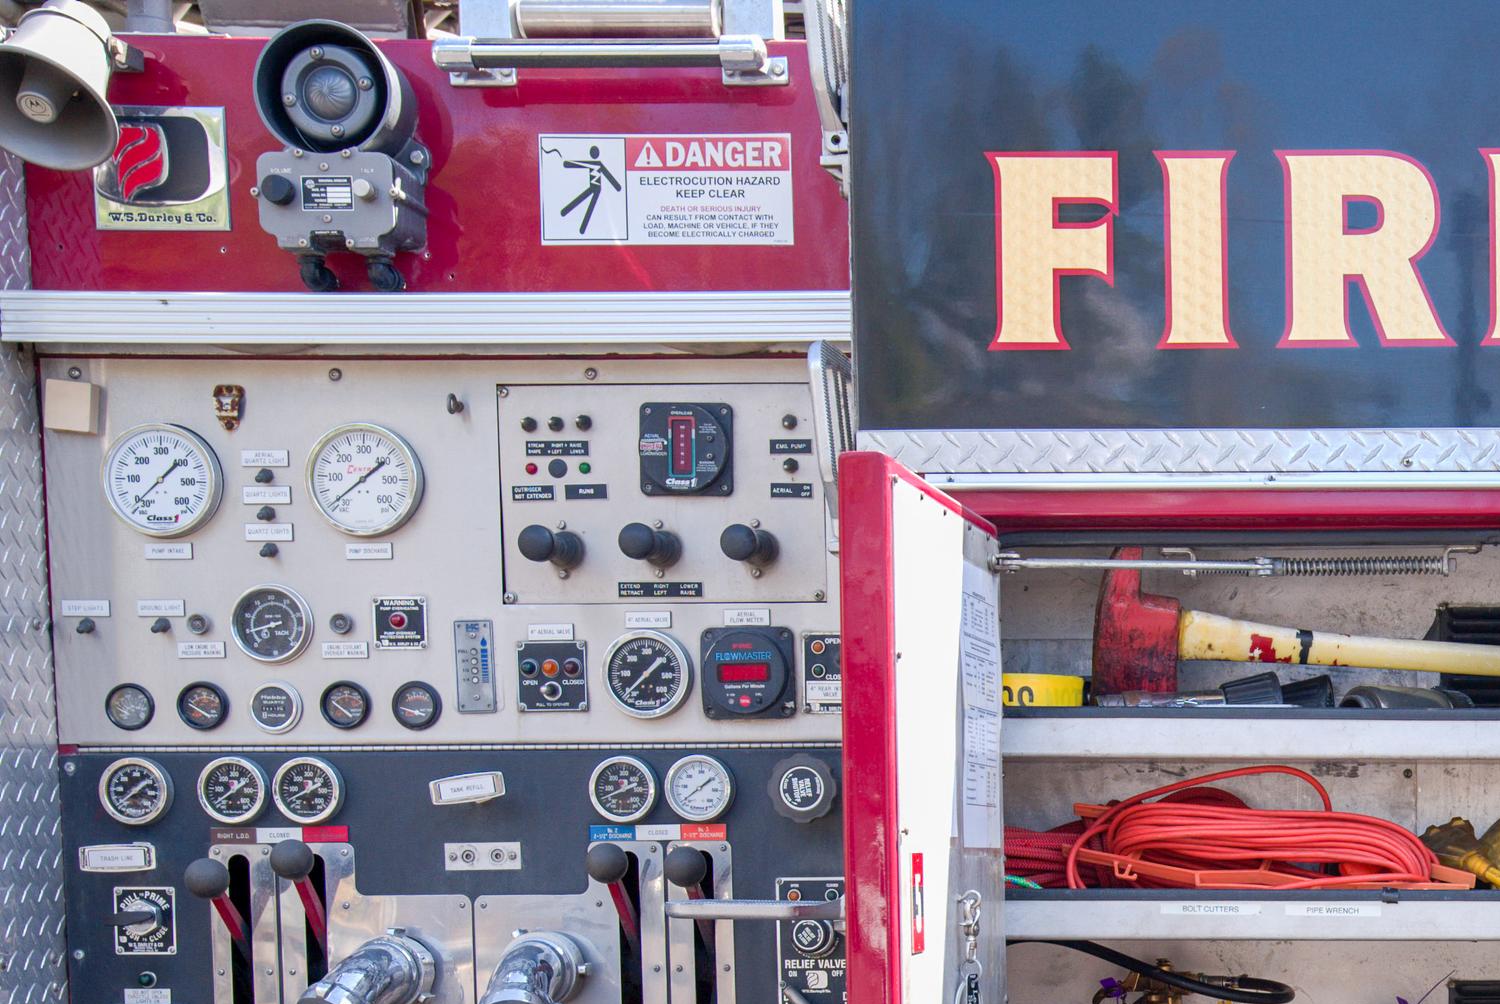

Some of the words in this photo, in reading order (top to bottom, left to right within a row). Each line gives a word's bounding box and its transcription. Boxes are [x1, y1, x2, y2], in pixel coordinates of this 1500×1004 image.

[666, 141, 782, 168] DANGER
[640, 176, 732, 186] ELECTROCUTION
[736, 176, 781, 186] HAZARD
[676, 189, 705, 199] KEEP
[709, 189, 745, 199] CLEAR
[660, 205, 686, 213] DEATH
[688, 205, 698, 213] OR
[700, 205, 733, 213] SERIOUS
[734, 205, 761, 213] INJURY
[184, 213, 193, 222] &
[643, 222, 665, 231] LOAD,
[716, 222, 750, 231] VEHICLE,
[153, 446, 169, 456] 300
[356, 445, 372, 454] 300
[134, 456, 150, 465] 200
[336, 453, 351, 463] 200
[127, 474, 141, 483] 100
[180, 477, 196, 487] 500
[328, 473, 343, 482] 100
[382, 475, 398, 485] 500
[174, 496, 190, 506] 600
[376, 494, 392, 504] 600
[715, 651, 772, 661] FLOWMASTER
[120, 892, 140, 909] PULL
[144, 891, 171, 911] PRIME
[1182, 905, 1203, 913] BOLT
[1204, 905, 1240, 914] CUTTERS
[1306, 906, 1324, 914] PIPE
[1326, 906, 1360, 915] WRENCH
[122, 926, 140, 942] USH
[149, 926, 169, 942] CLOSE
[785, 959, 815, 969] RELIEF
[818, 959, 847, 969] VALVE
